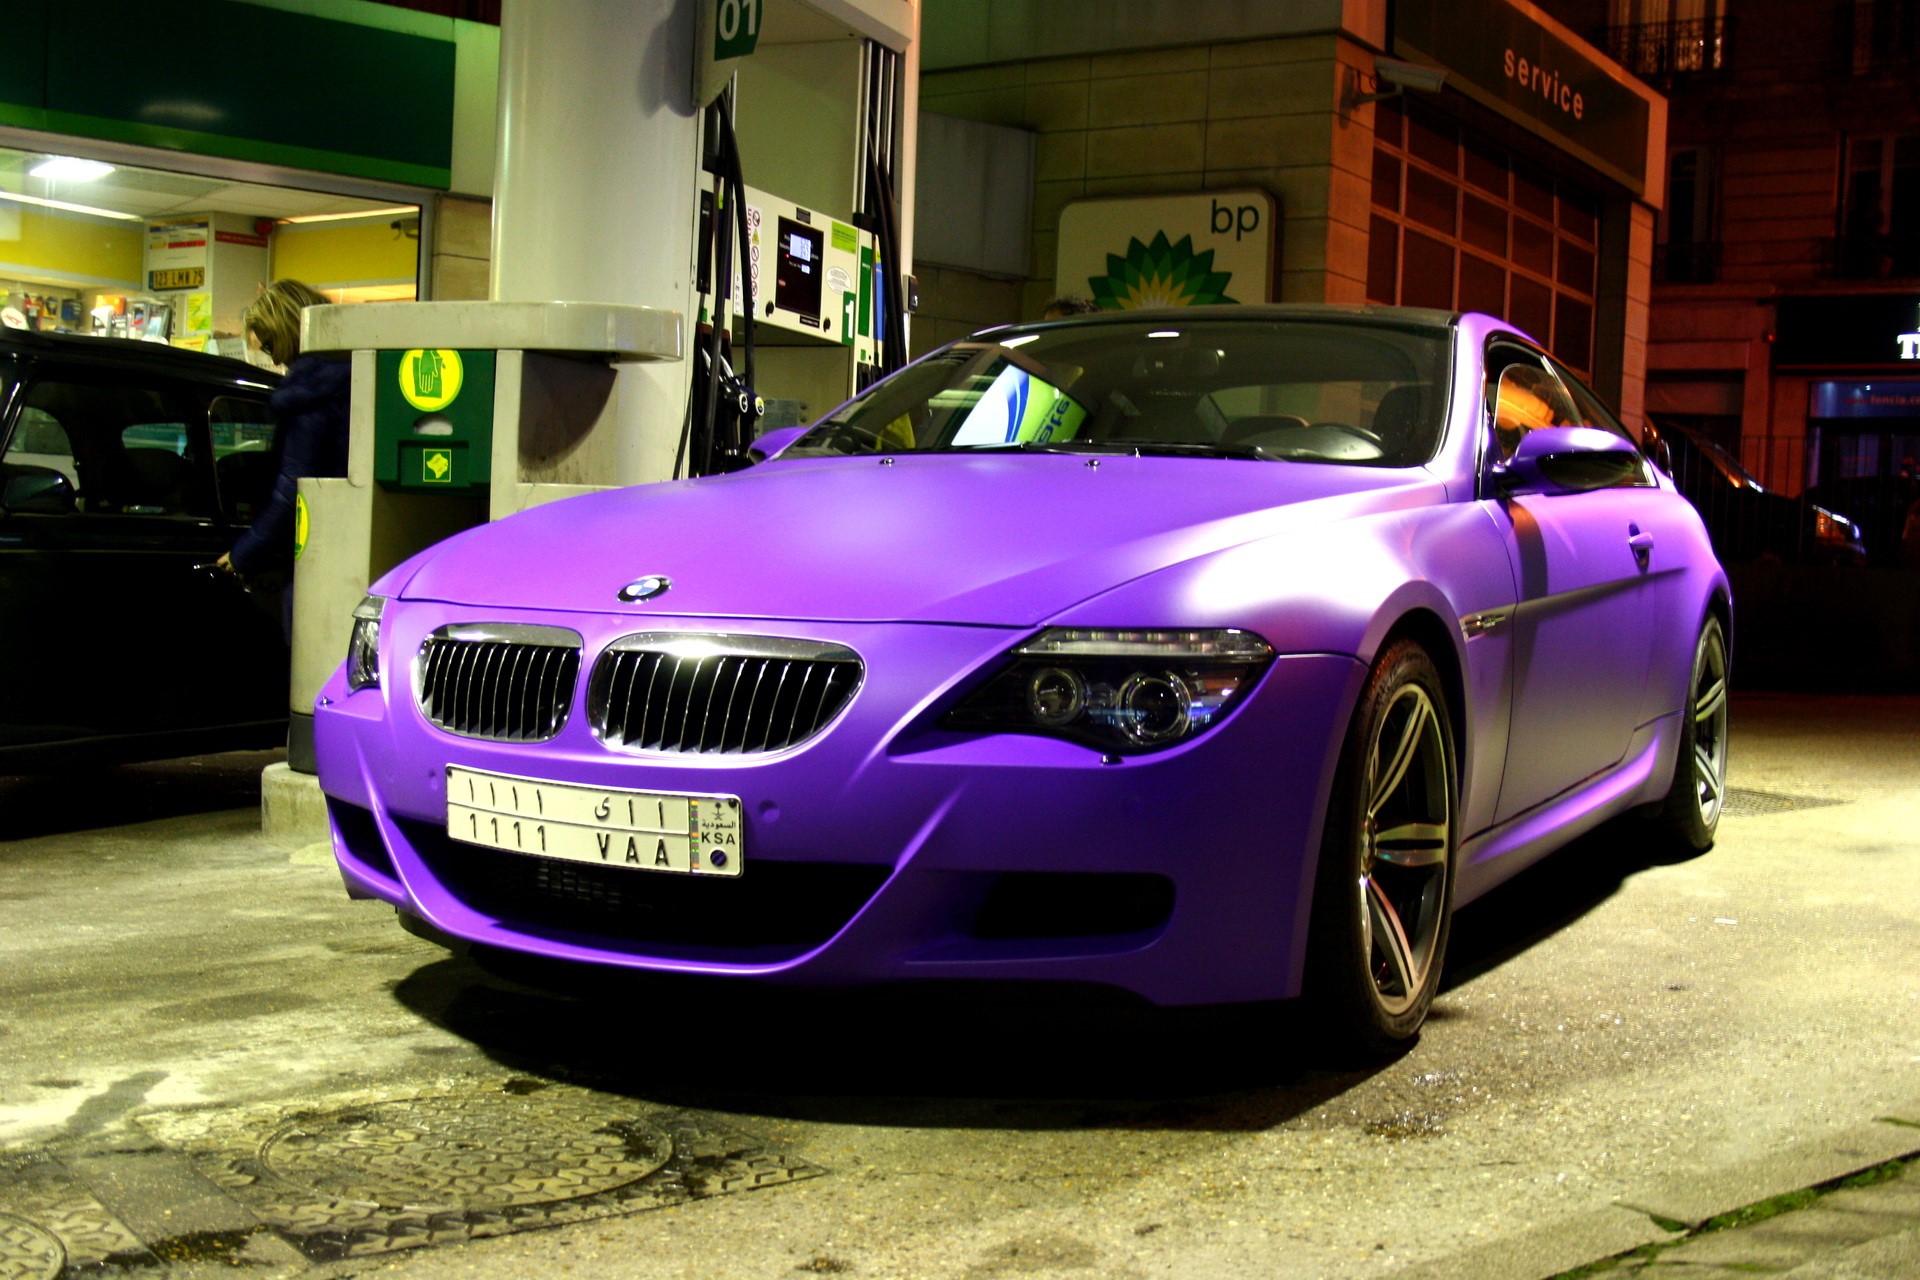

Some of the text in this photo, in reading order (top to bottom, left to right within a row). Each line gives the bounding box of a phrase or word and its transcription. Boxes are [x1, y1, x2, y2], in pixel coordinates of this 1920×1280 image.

[719, 0, 757, 41] 01
[1504, 48, 1583, 120] service
[1211, 199, 1260, 242] bp
[845, 300, 855, 339] 1
[470, 813, 670, 867] 1111 VAA
[701, 832, 735, 845] KSA
